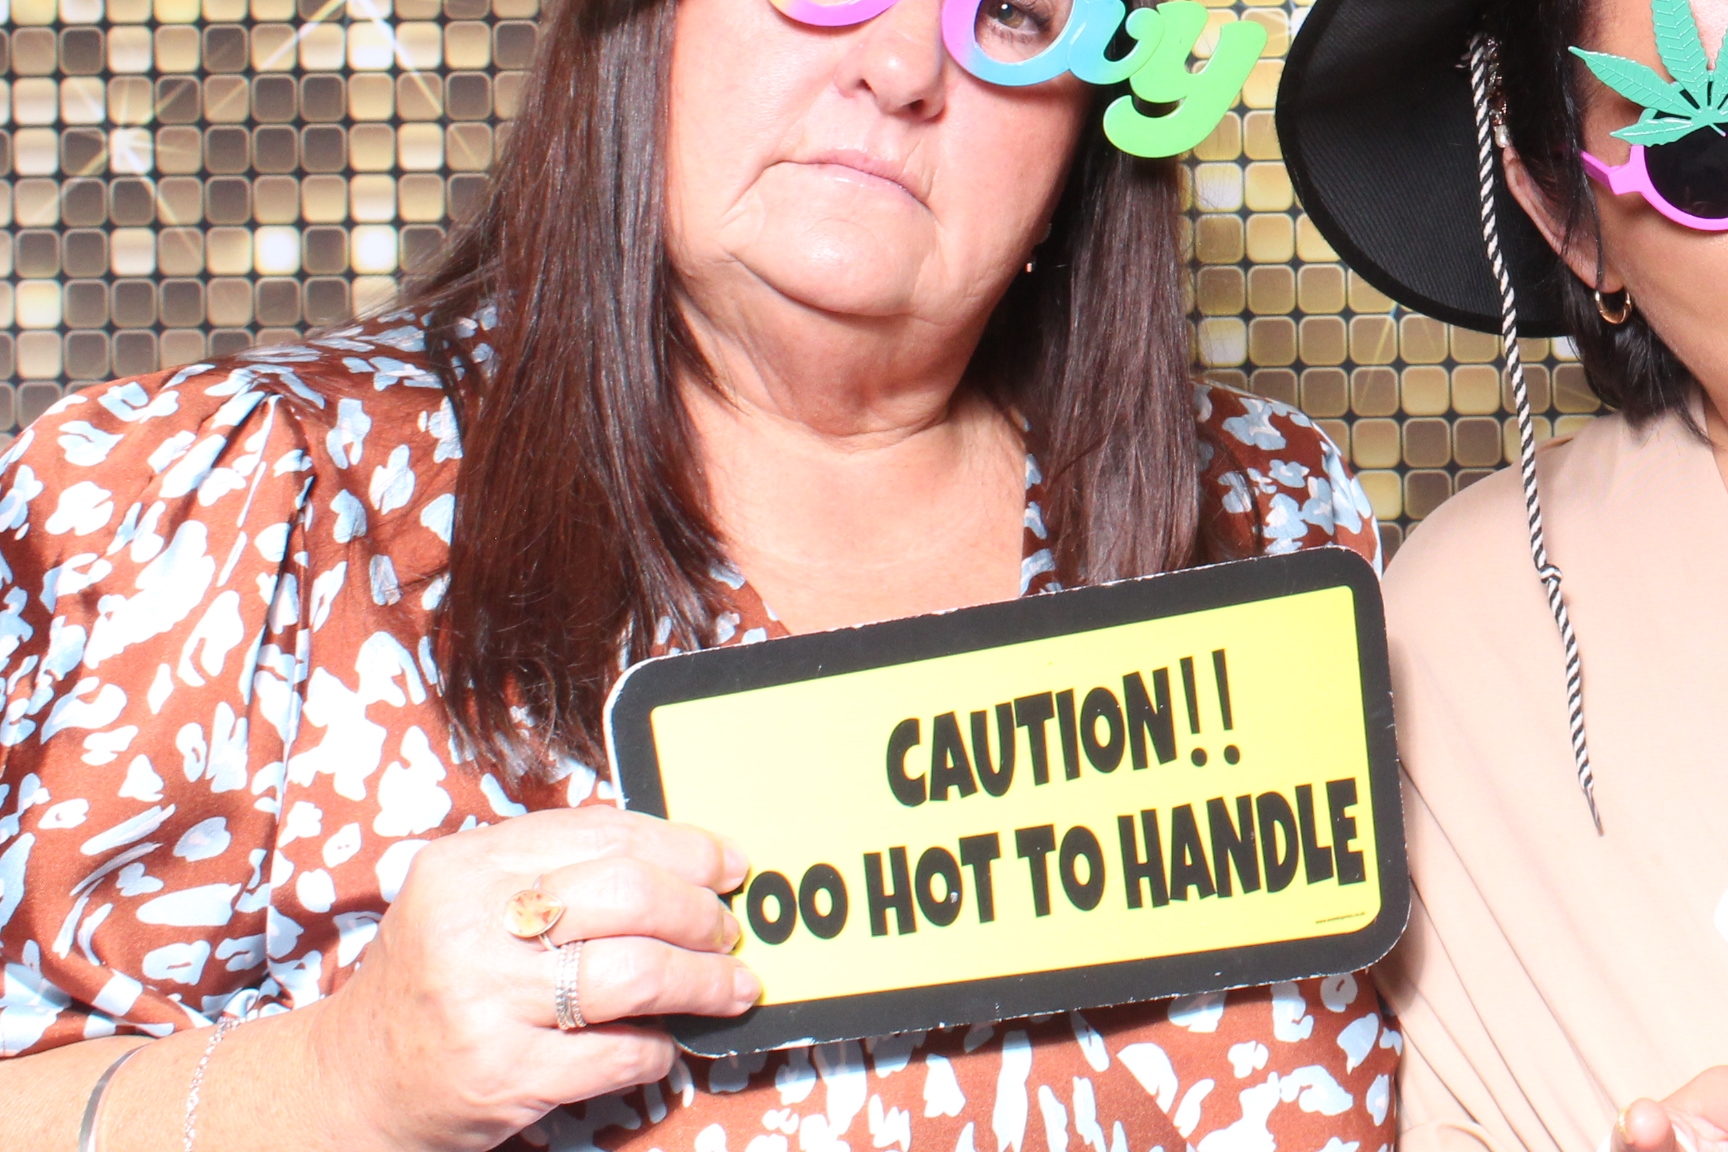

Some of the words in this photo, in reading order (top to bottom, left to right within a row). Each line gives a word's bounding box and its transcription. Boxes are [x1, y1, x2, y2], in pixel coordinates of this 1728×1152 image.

[886, 650, 1240, 808] CAUTION!!
[716, 864, 849, 946] OO
[863, 833, 1000, 936] HOT
[1015, 825, 1106, 917] TO
[1117, 779, 1366, 909] HANDLE
